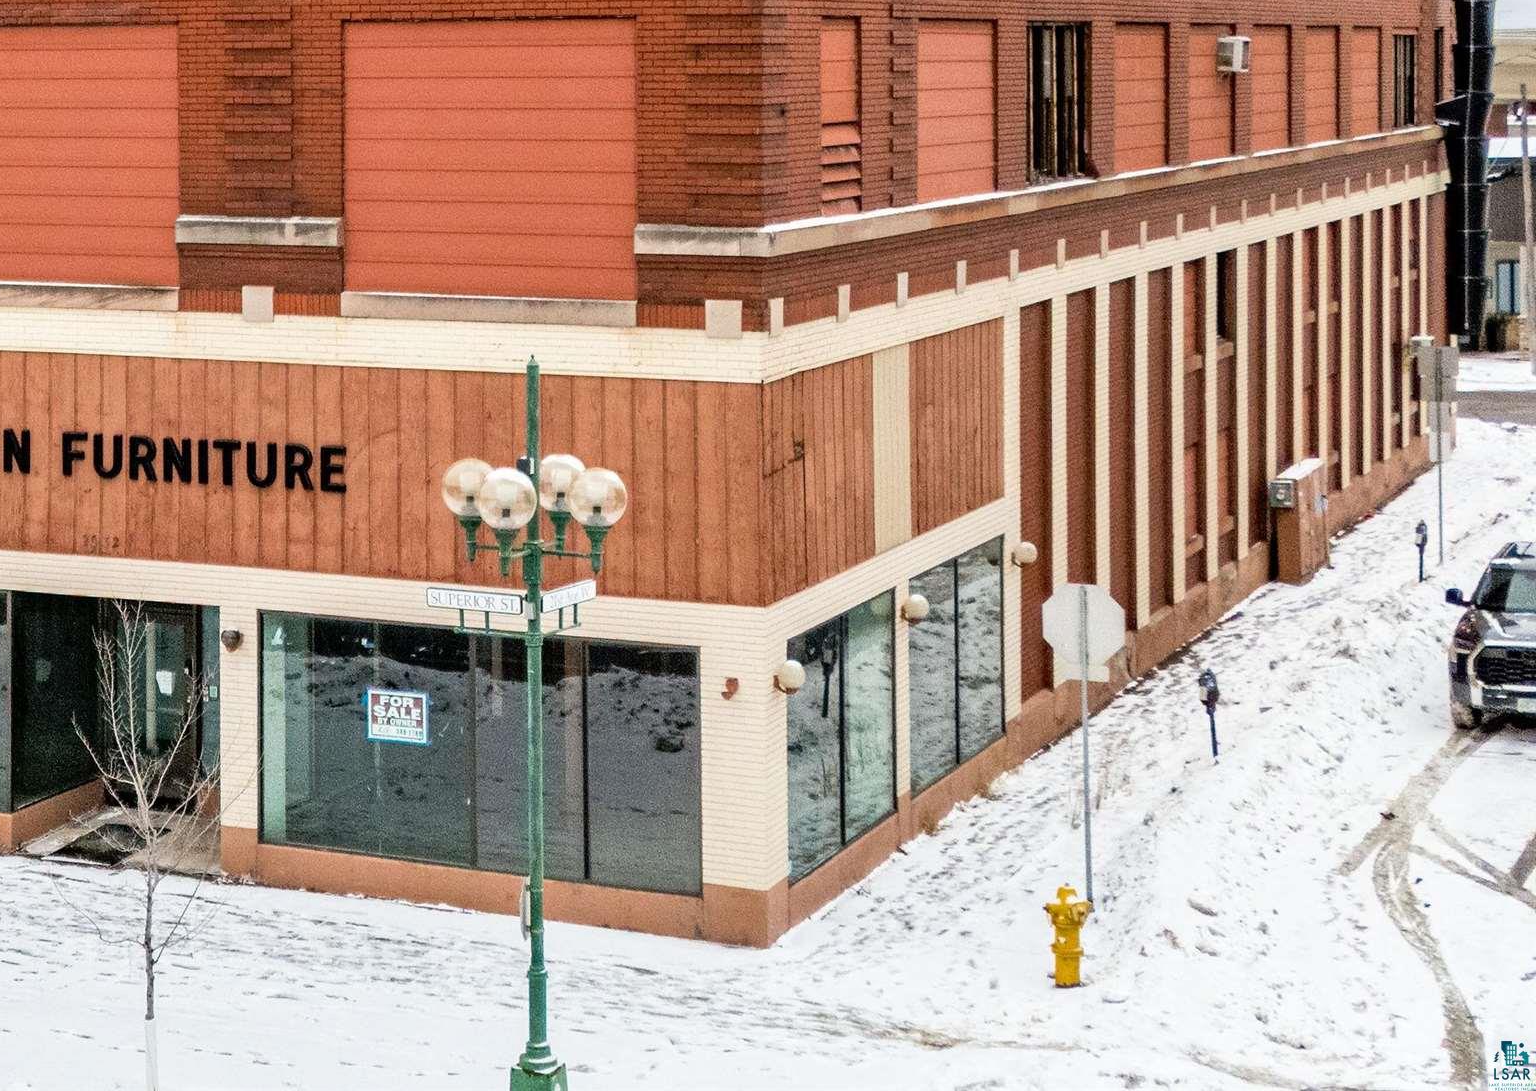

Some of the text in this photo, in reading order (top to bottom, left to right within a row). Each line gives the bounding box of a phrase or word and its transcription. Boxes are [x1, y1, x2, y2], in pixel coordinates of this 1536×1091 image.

[63, 431, 347, 493] FURNITURE
[430, 591, 496, 611] SUPERIOR
[379, 695, 414, 708] FOR
[373, 705, 422, 720] SALE
[377, 717, 417, 727] BY OWNER
